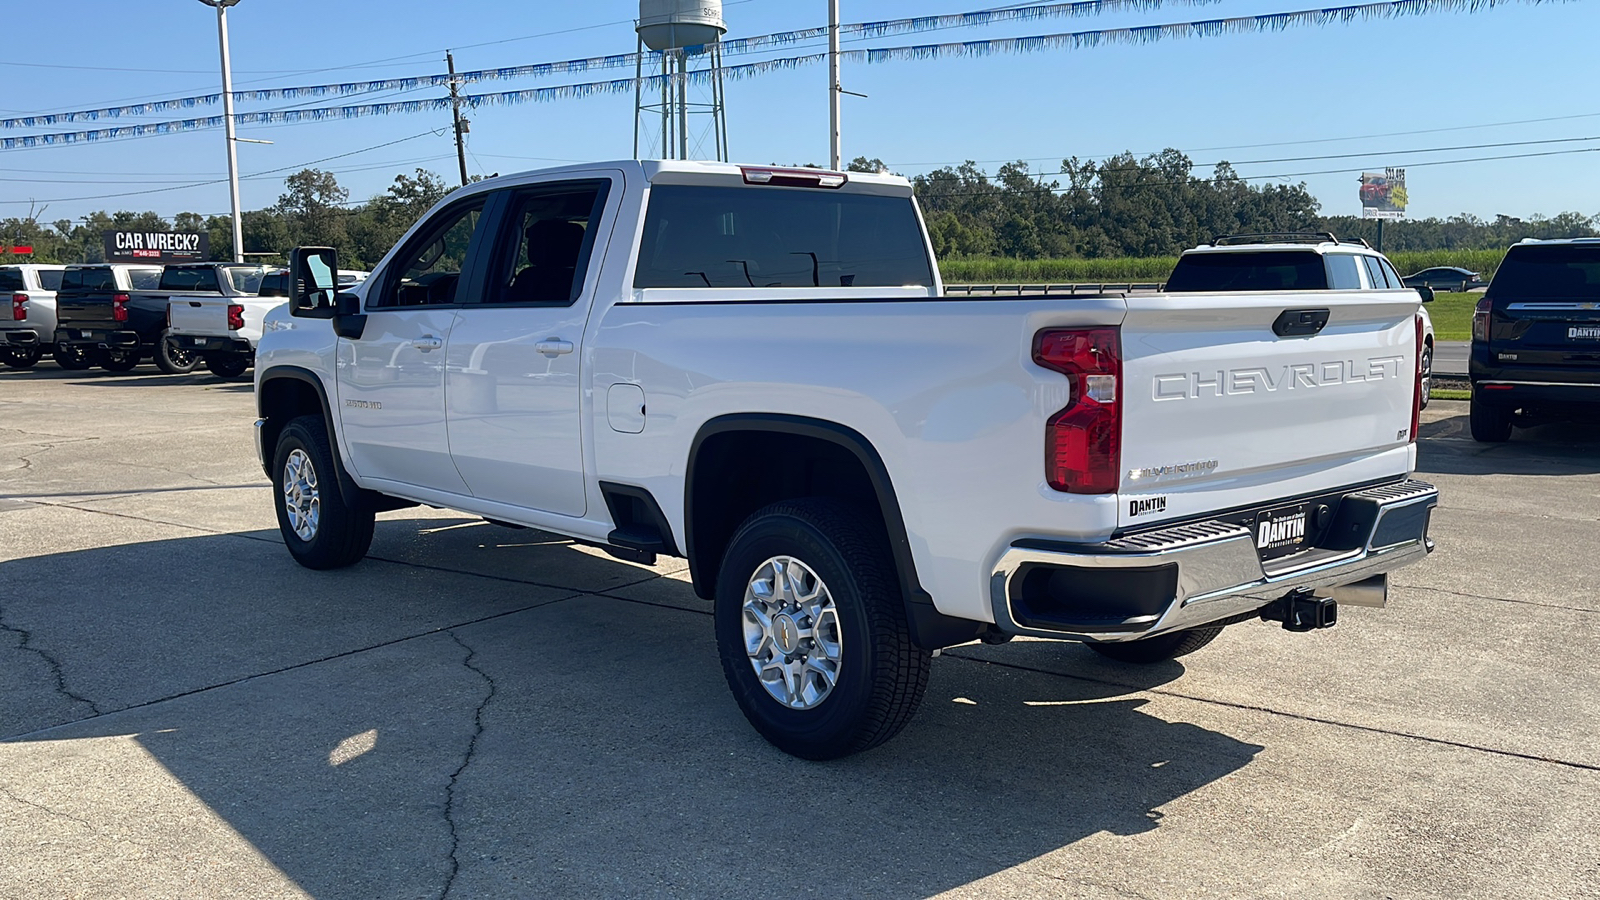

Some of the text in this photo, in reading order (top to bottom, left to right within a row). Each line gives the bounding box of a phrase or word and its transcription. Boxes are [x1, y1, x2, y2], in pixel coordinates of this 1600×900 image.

[115, 232, 199, 250] CAR WRECK?
[1152, 354, 1404, 402] CHEVROLET
[1129, 496, 1166, 517] DANTIN
[1258, 517, 1305, 548] DANTIN
